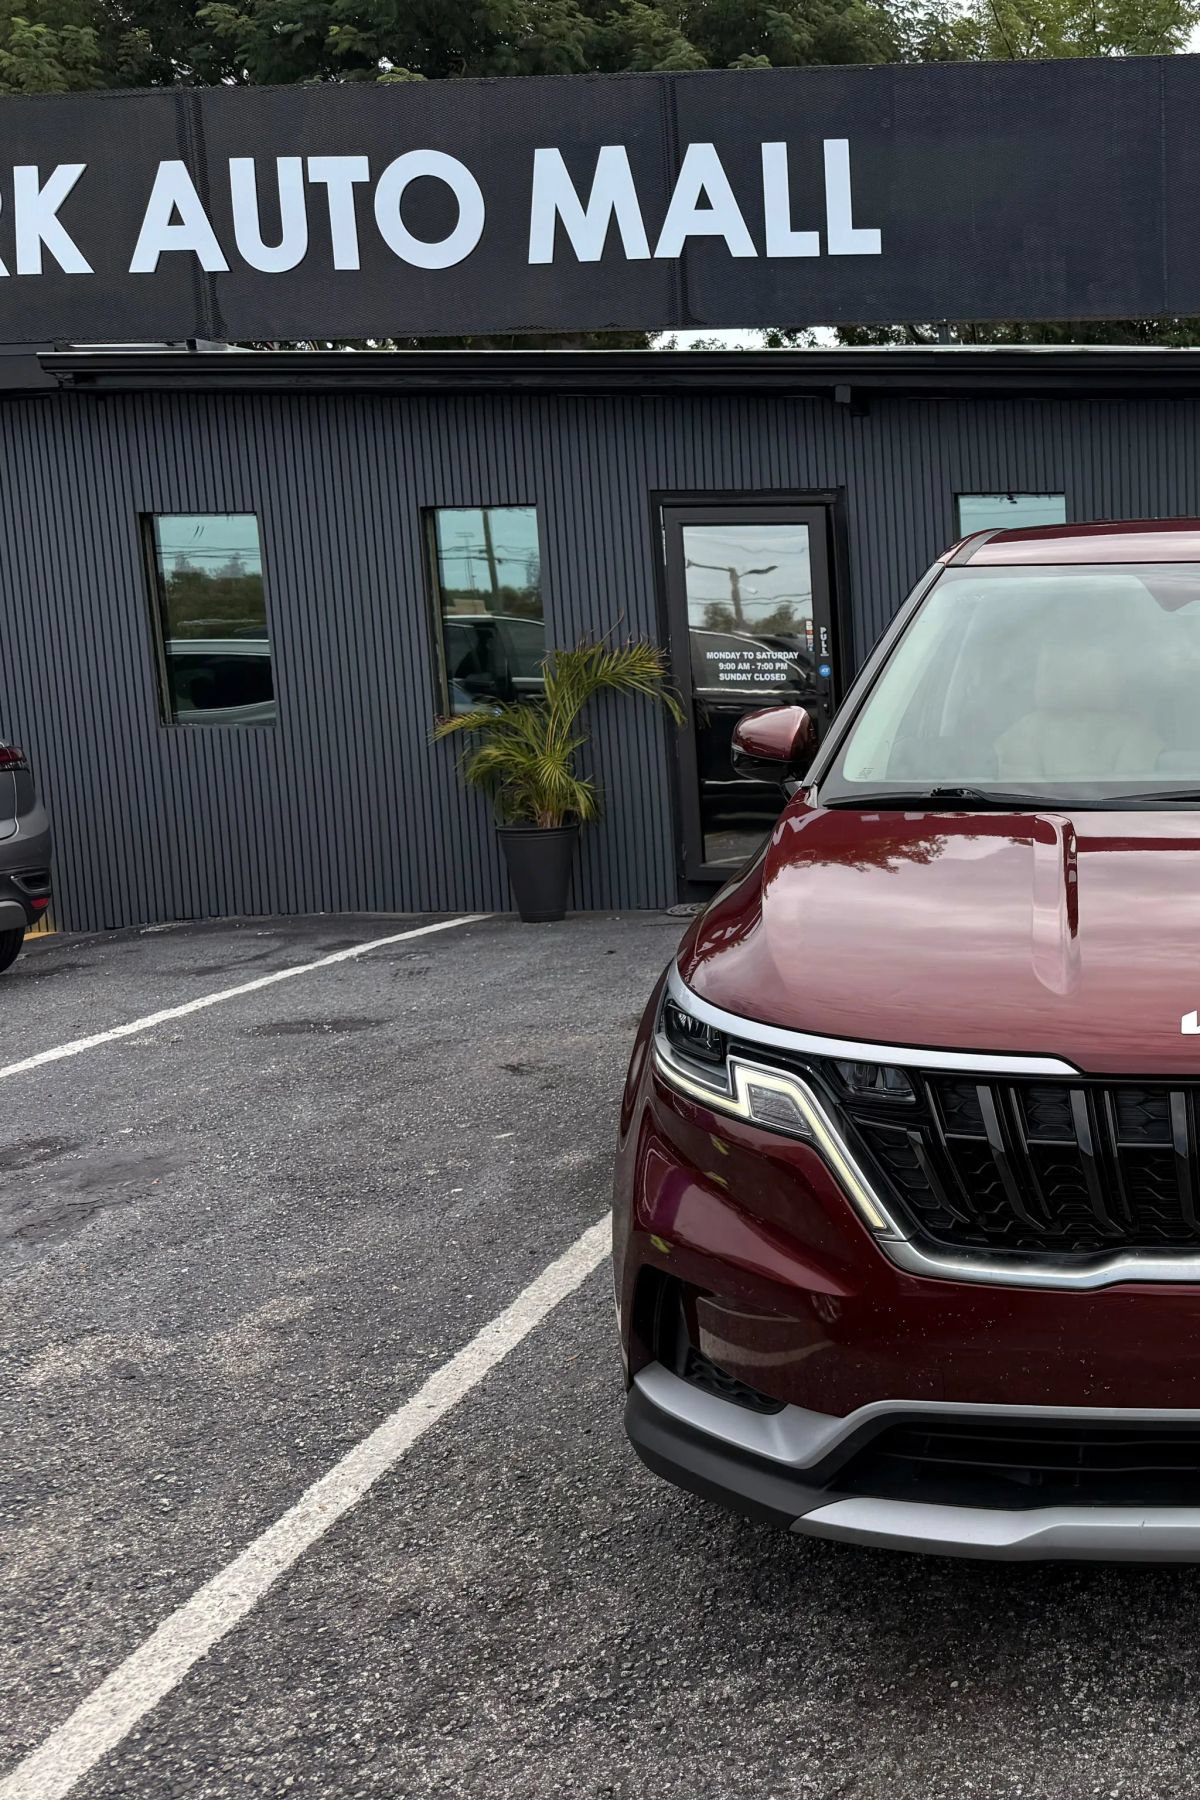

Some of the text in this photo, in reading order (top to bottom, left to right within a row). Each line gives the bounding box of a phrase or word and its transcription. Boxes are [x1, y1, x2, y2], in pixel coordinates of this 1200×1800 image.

[0, 138, 882, 276] K AUTO MALL
[719, 673, 787, 681] SUNDAY CLOSED
